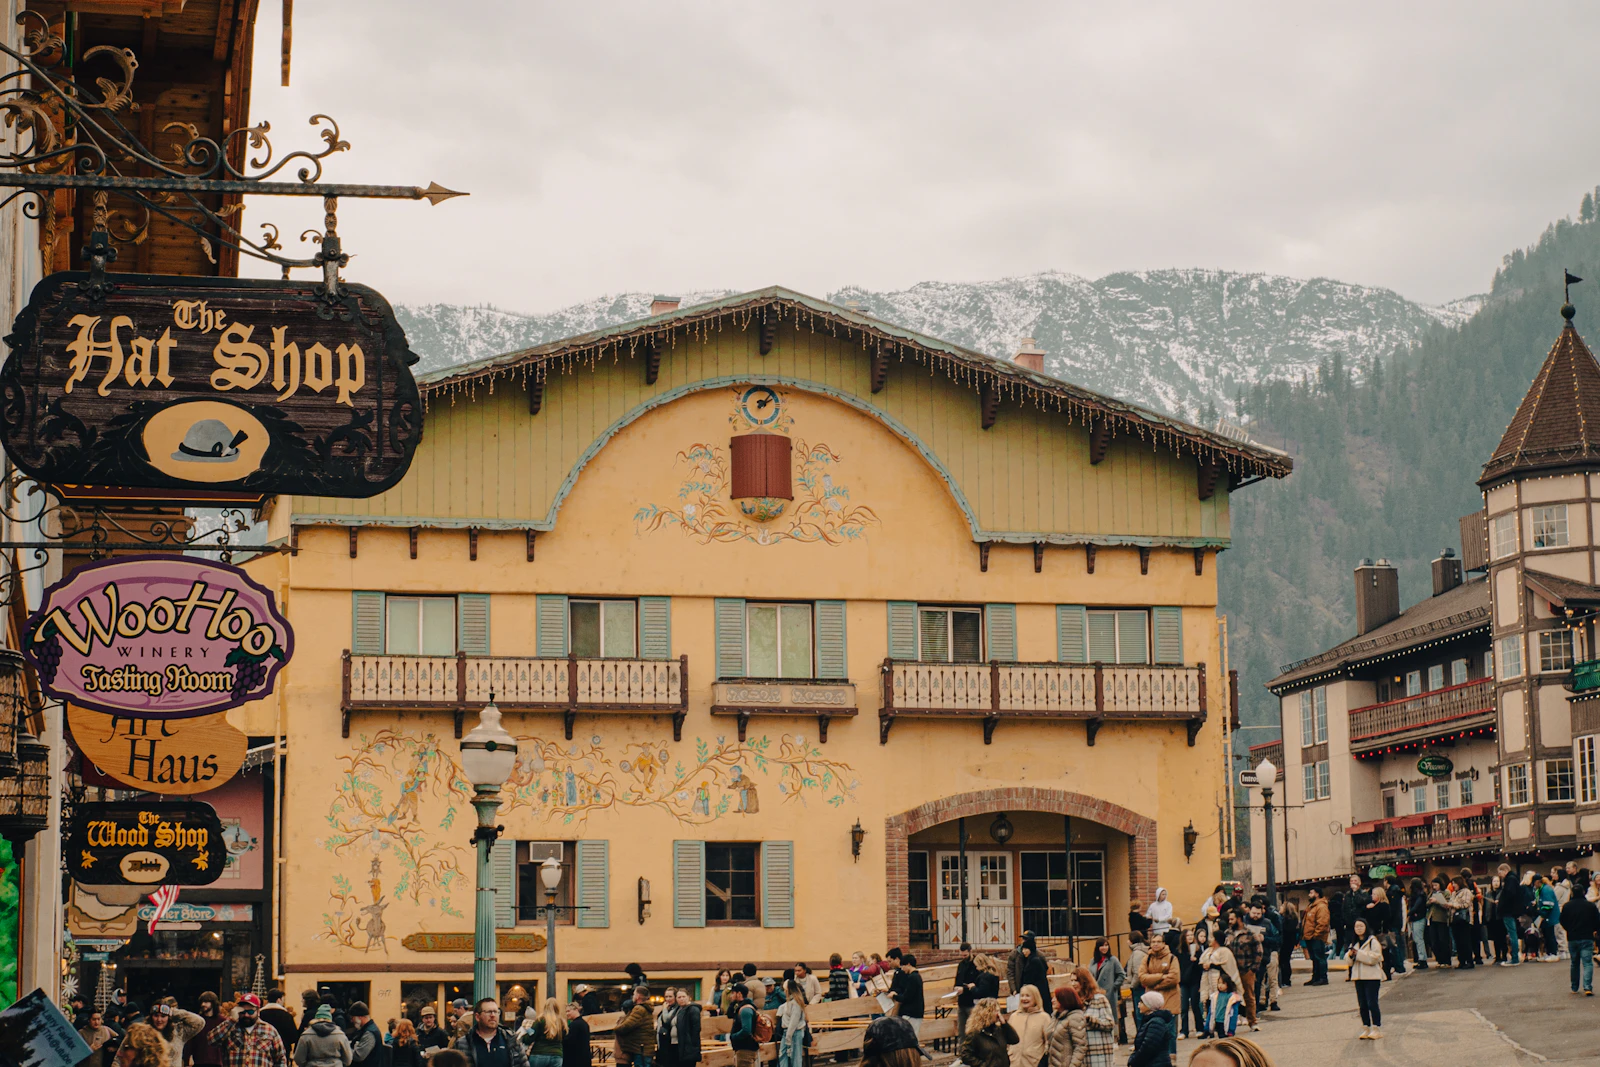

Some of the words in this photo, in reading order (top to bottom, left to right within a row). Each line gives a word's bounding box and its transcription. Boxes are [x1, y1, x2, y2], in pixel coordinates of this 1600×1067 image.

[172, 300, 227, 334] The
[64, 313, 178, 397] Hat
[210, 321, 366, 407] Shop
[33, 581, 276, 656] WooHoo
[117, 646, 210, 658] WINERY
[81, 664, 163, 696] Tasting
[165, 664, 234, 692] Room
[121, 737, 219, 784] Haus
[138, 811, 160, 826] The
[87, 820, 149, 848] Wood
[154, 820, 209, 852] Shop
[141, 908, 180, 920] Coner
[181, 906, 212, 920] Store
